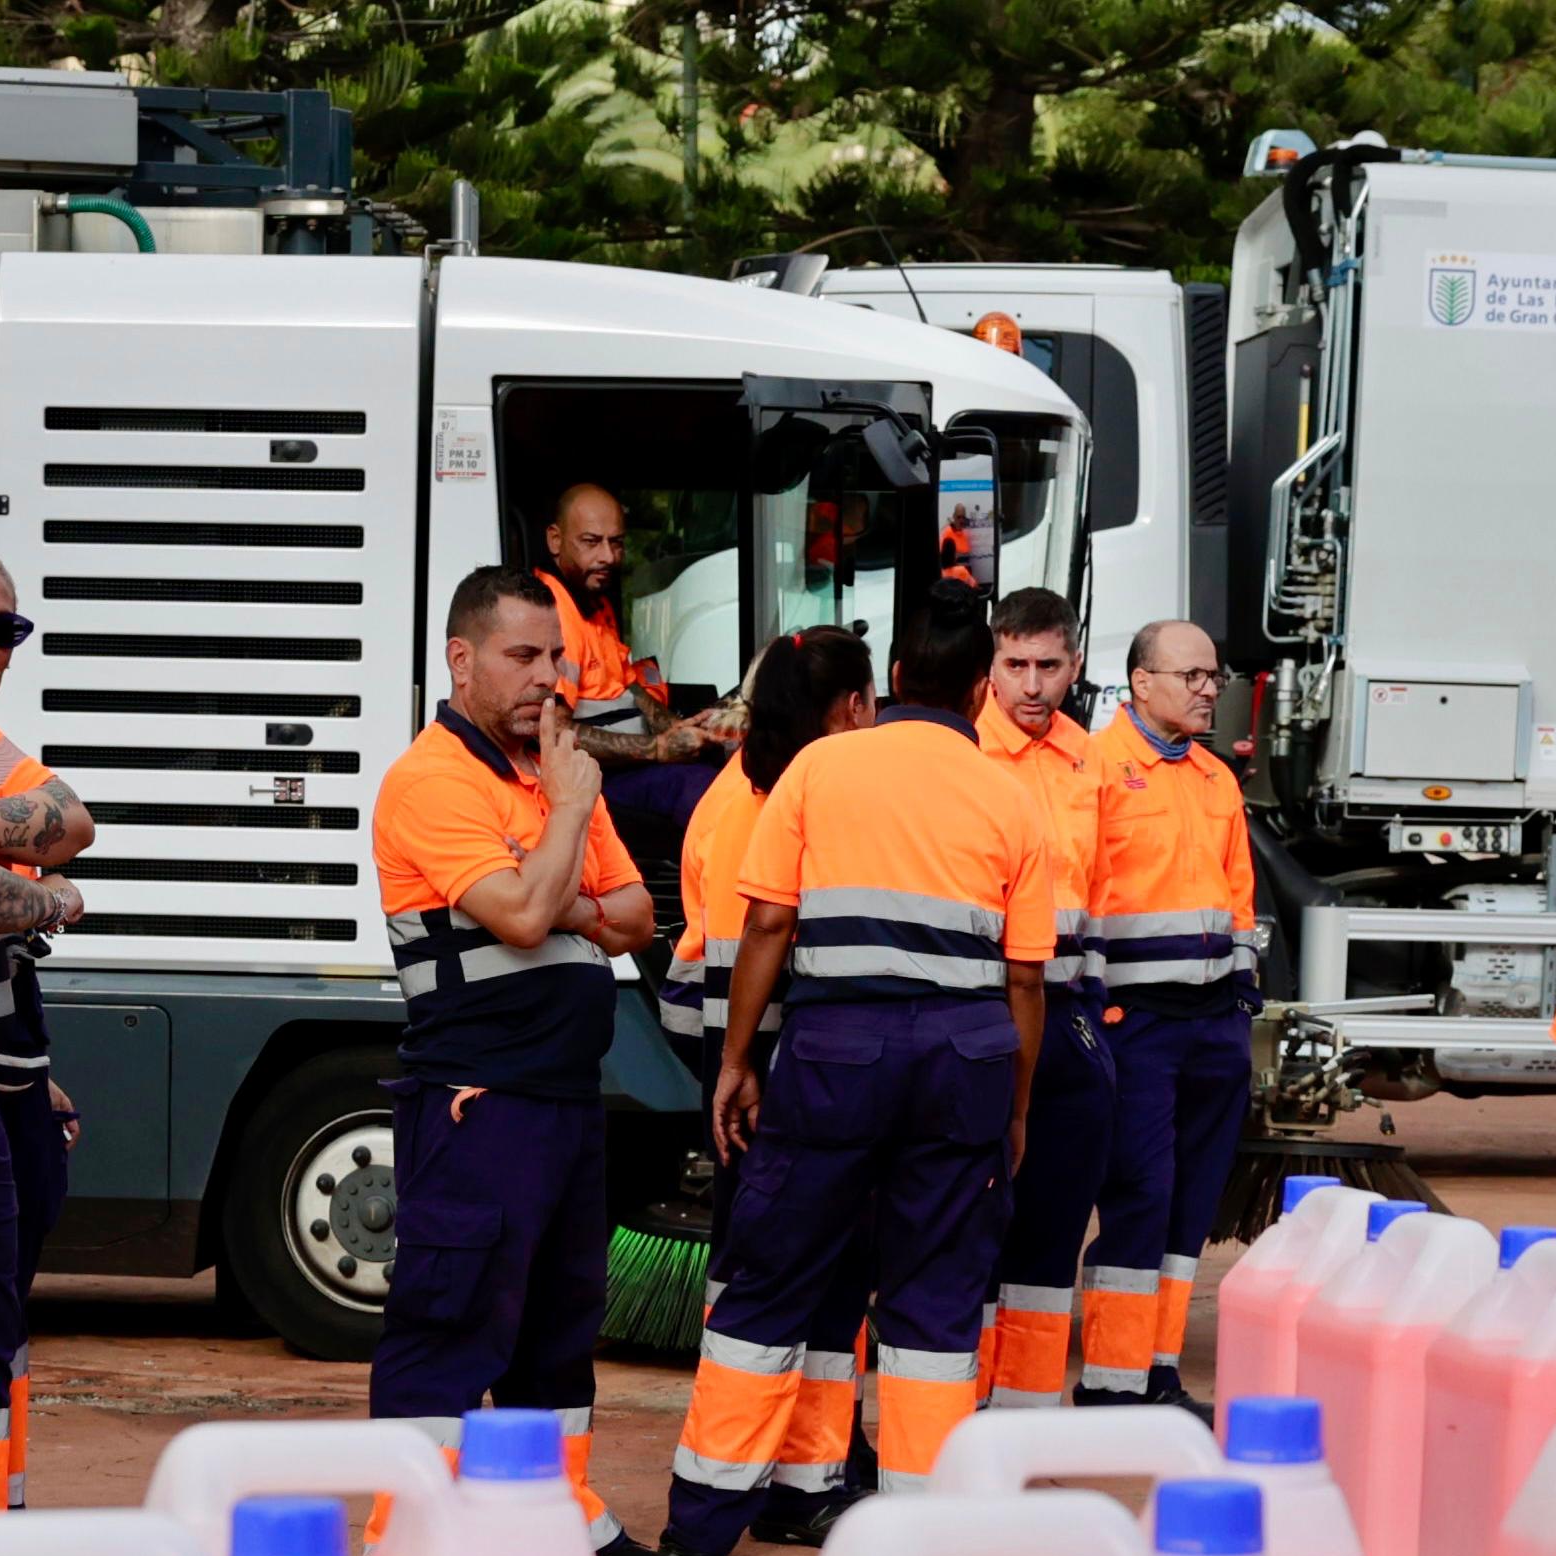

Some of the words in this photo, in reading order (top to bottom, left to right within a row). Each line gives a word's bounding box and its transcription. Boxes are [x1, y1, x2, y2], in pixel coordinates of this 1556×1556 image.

[1486, 290, 1507, 305] de
[1517, 292, 1545, 307] Las
[1485, 309, 1506, 323] de
[1509, 310, 1548, 325] Gran
[1102, 685, 1132, 705] FC
